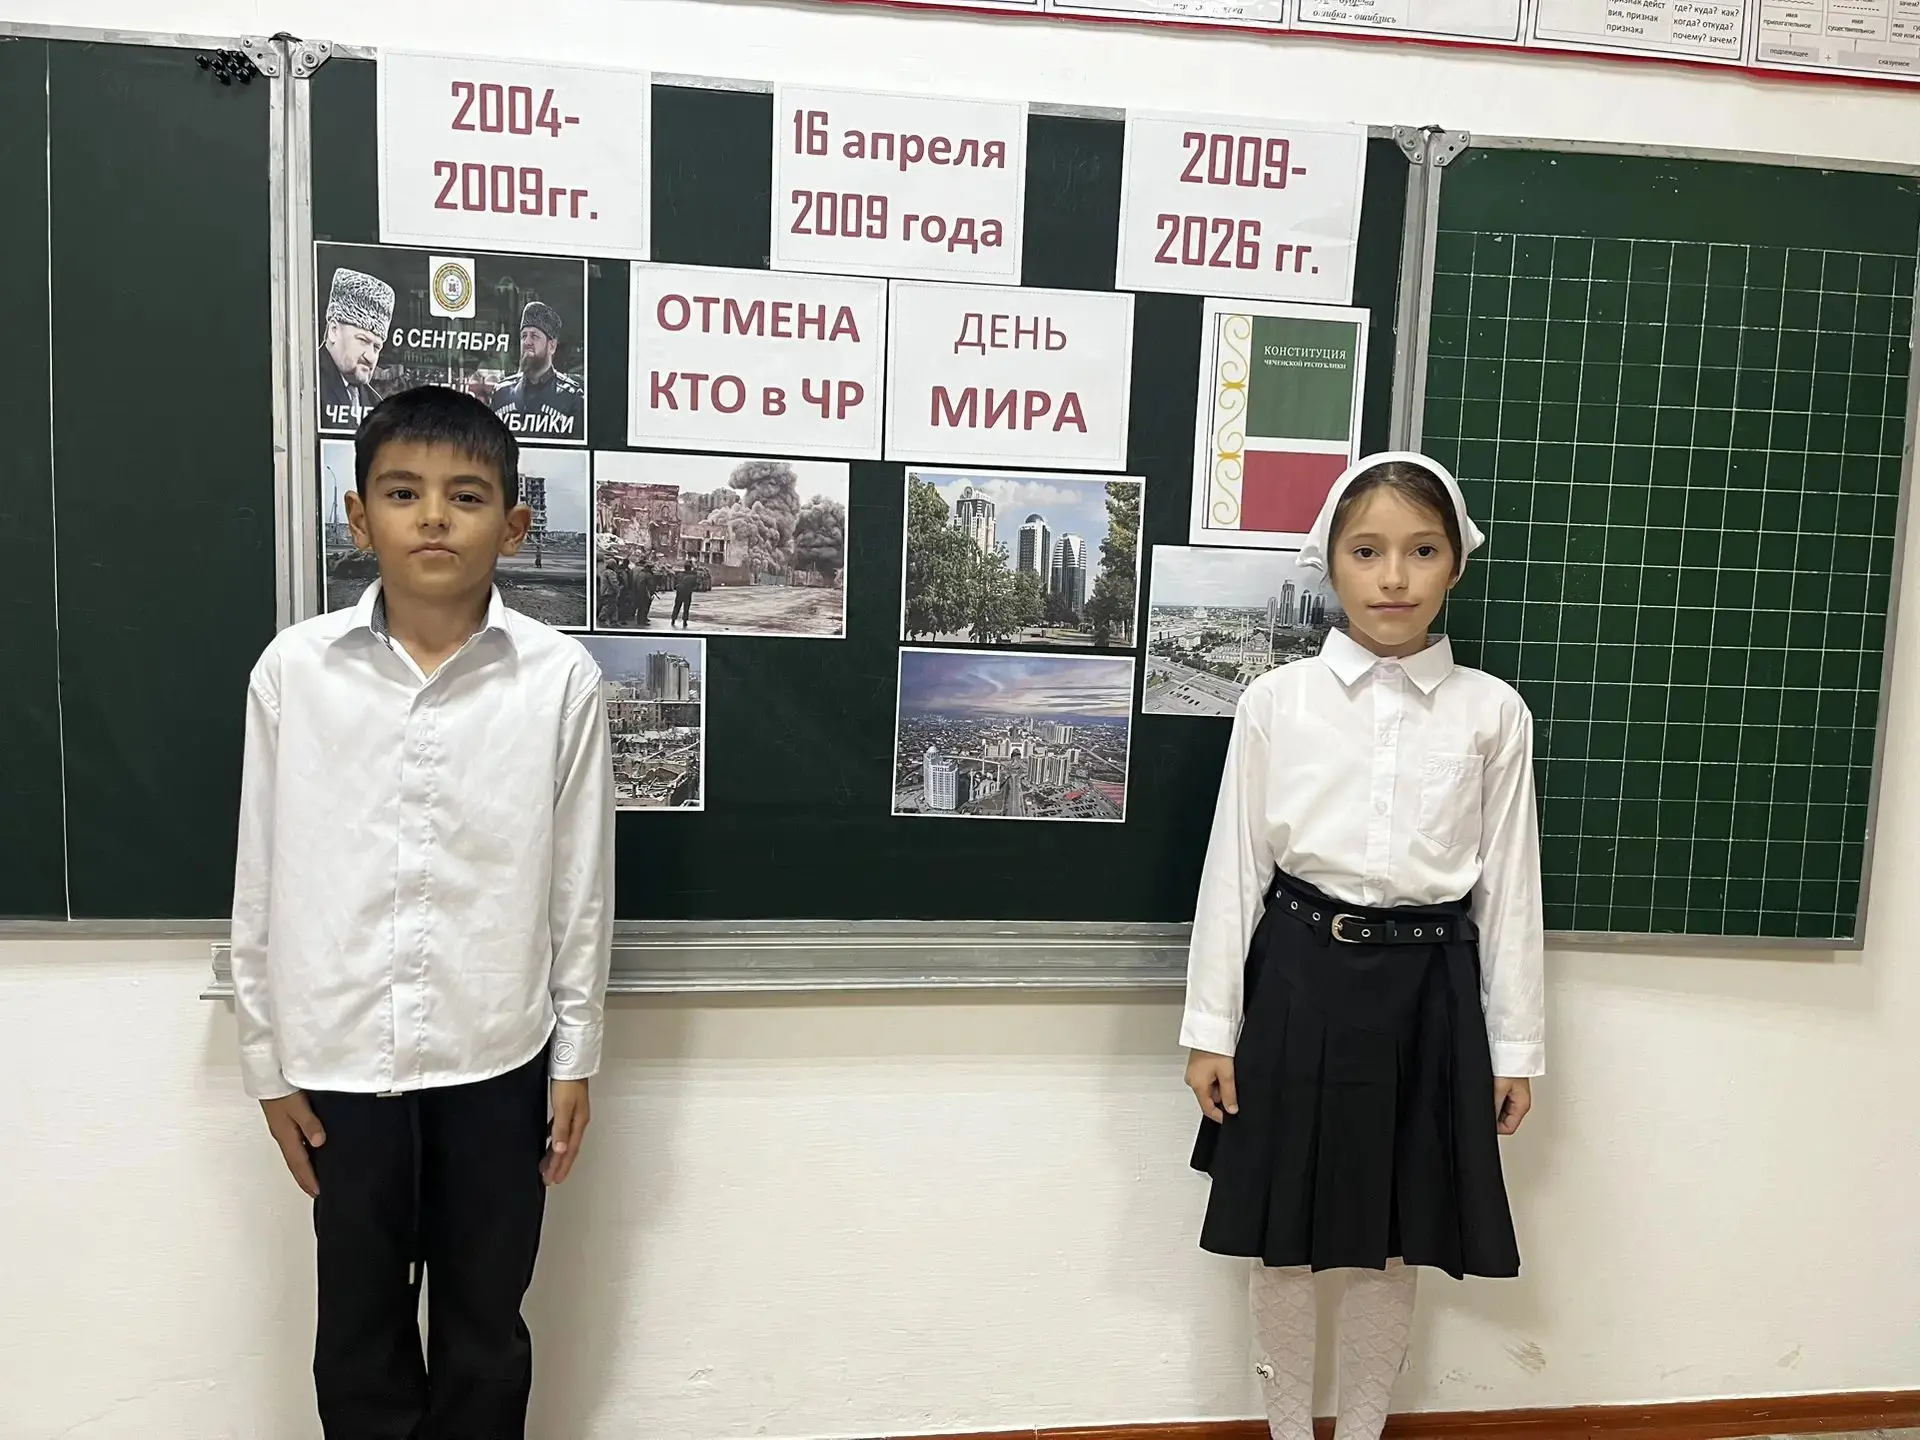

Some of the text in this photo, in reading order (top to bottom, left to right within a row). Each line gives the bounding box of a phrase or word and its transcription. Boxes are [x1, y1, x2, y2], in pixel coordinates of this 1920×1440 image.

[451, 81, 580, 138] 2004-
[793, 109, 1006, 172] 16 апреля
[1180, 131, 1307, 190] 2009-
[434, 160, 598, 220] 2009гг.
[790, 189, 1003, 255] 2009 года
[1154, 213, 1319, 275] 2026 гг.
[391, 329, 511, 354] 6 СЕНТЯБРЯ
[656, 293, 861, 343] ОТМЕНА
[953, 312, 1067, 356] ДЕНЬ
[1264, 345, 1347, 360] КОНСТИТУЦИЯ
[650, 370, 865, 420] КТО в ЧР
[930, 385, 1088, 434] МИРА
